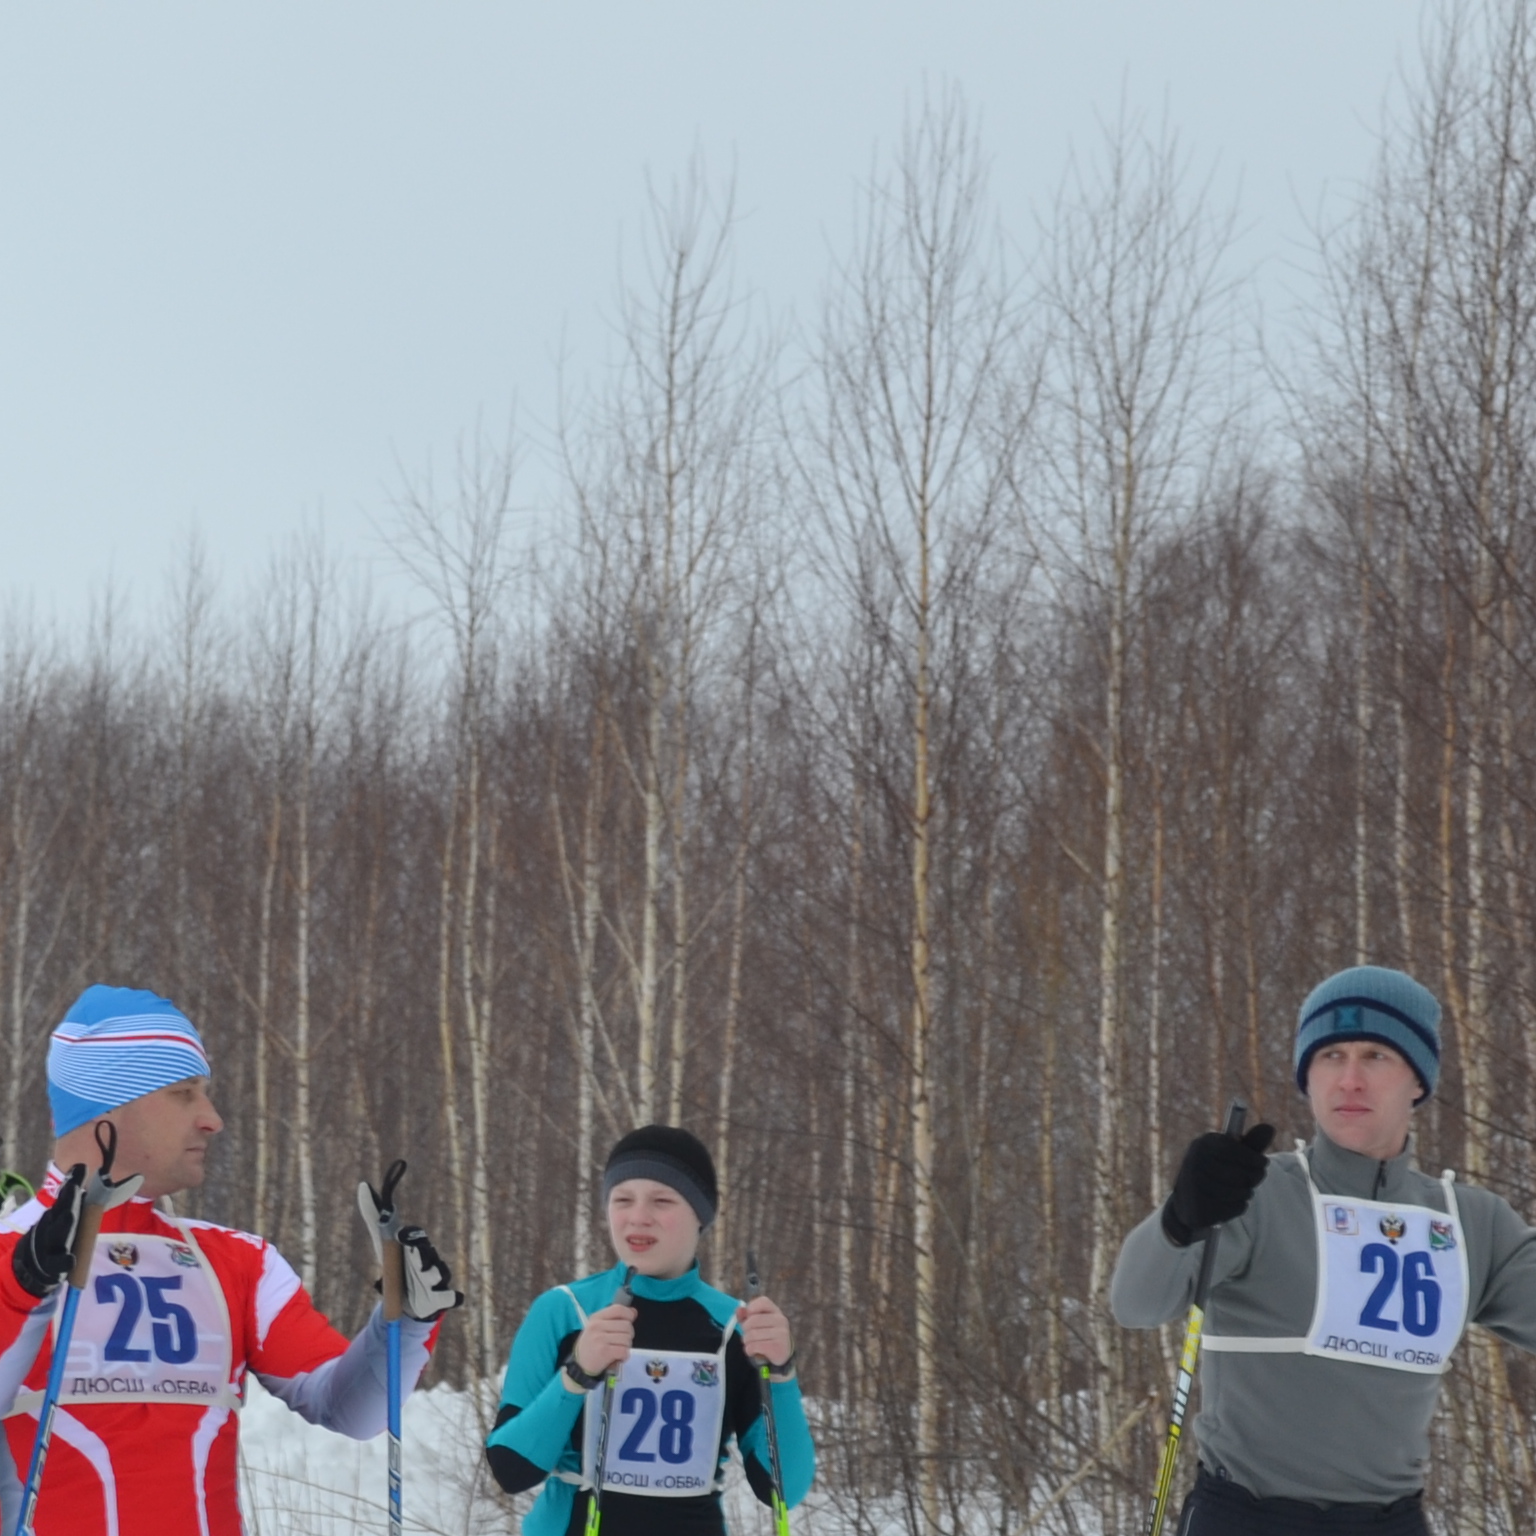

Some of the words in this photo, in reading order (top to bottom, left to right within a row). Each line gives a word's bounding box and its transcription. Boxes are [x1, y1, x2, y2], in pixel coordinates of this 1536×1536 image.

[95, 1273, 198, 1364] 25
[1359, 1243, 1442, 1337] 26
[1324, 1335, 1388, 1358] ДЮСШ
[72, 1377, 144, 1396] ДЮСШ
[618, 1387, 695, 1464] 28
